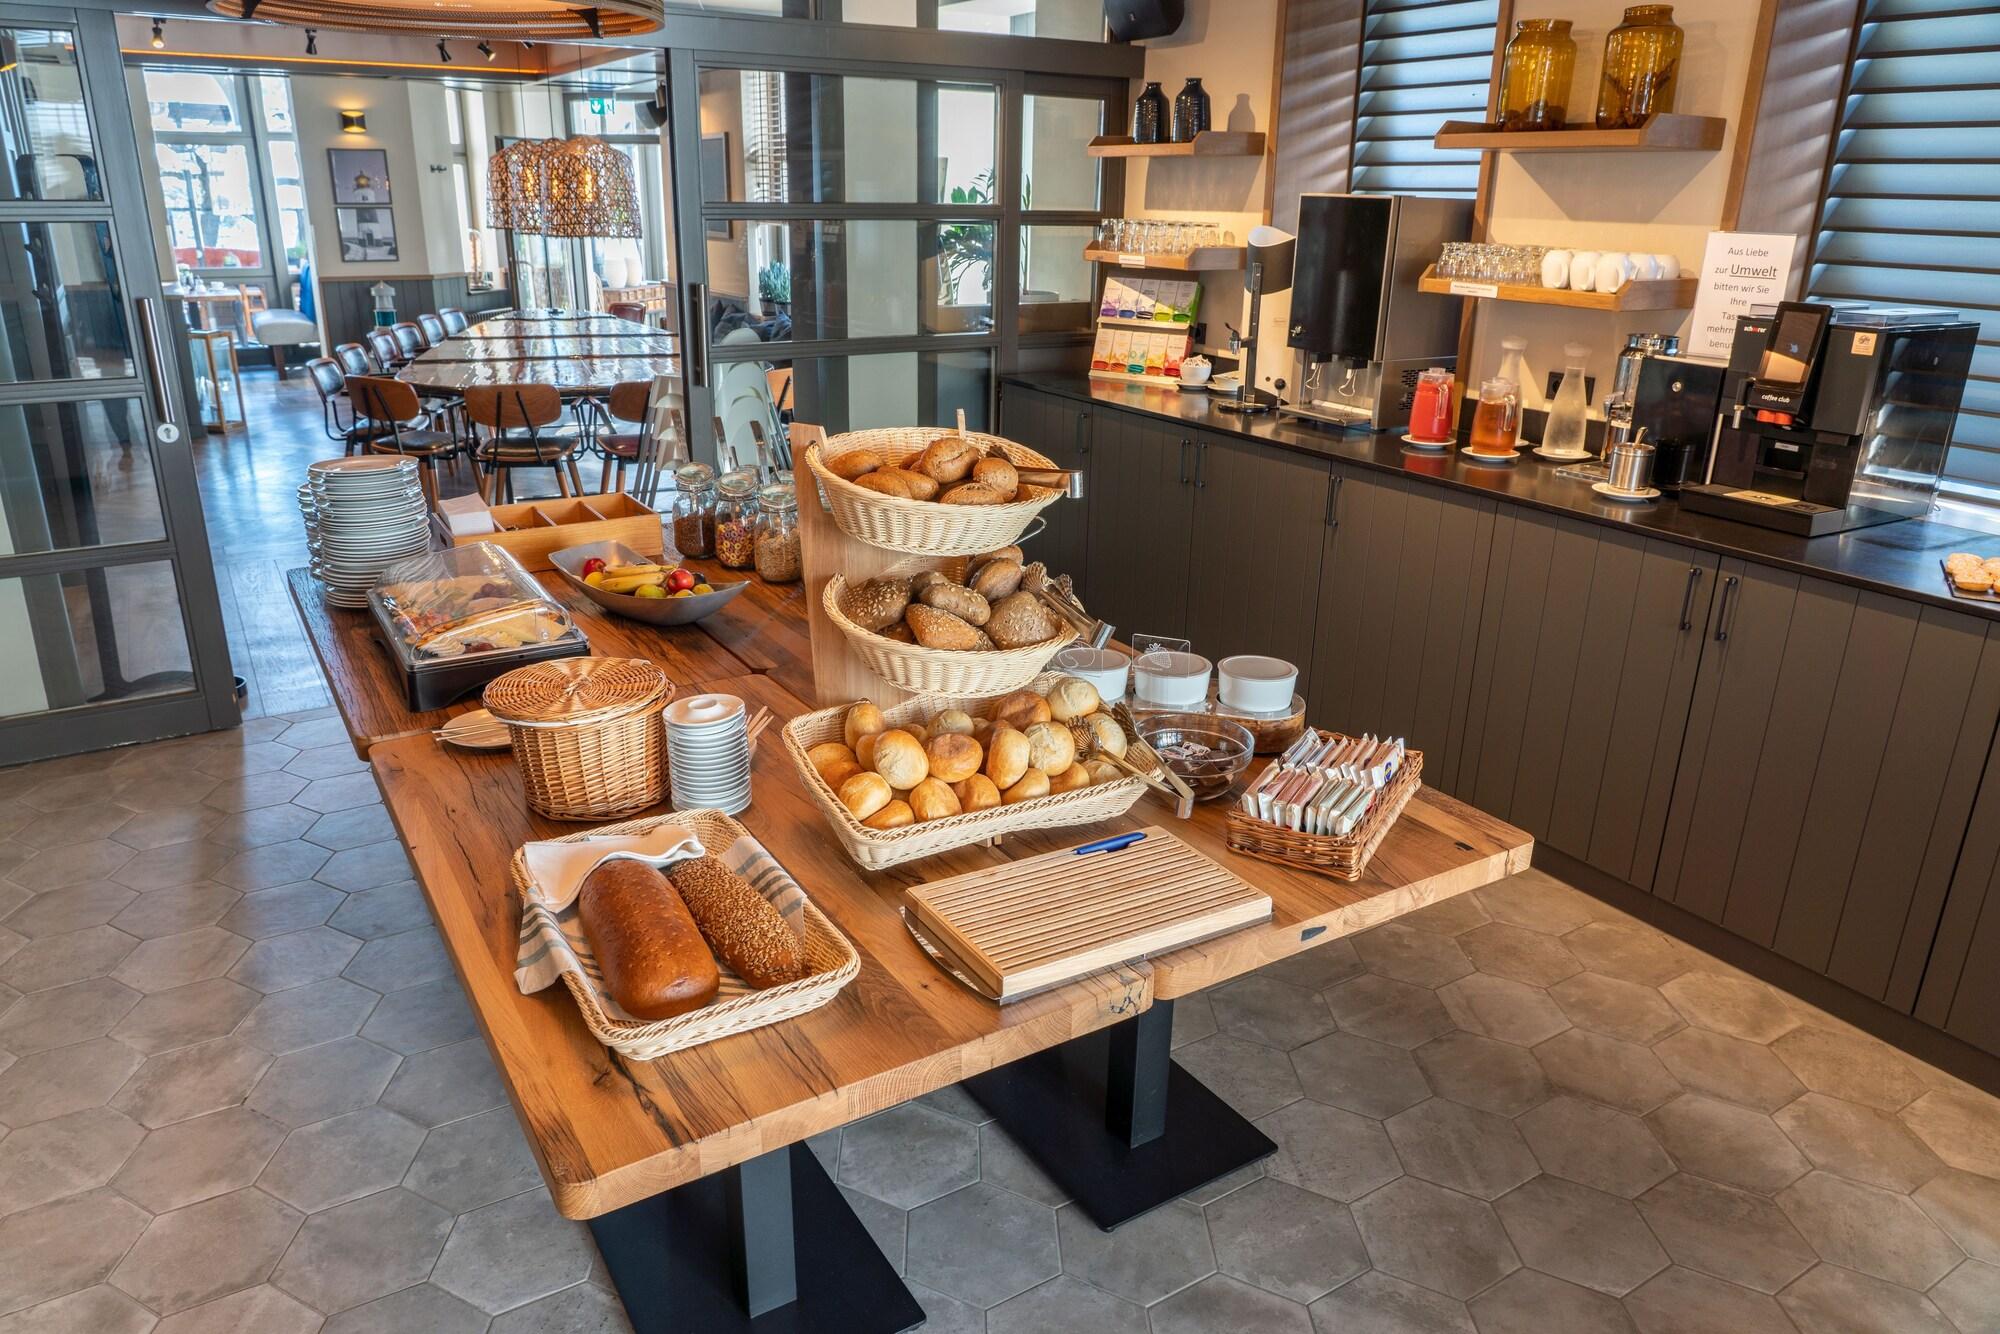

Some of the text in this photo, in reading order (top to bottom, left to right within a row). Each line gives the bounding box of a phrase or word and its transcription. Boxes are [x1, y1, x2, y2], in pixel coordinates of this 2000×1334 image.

[1728, 247, 1769, 257] Aus Liebe
[1714, 264, 1778, 279] zur Umwelt
[1714, 282, 1770, 294] bitten wir Sie
[1730, 298, 1747, 306] Ihre
[1761, 393, 1791, 404] coffee club
